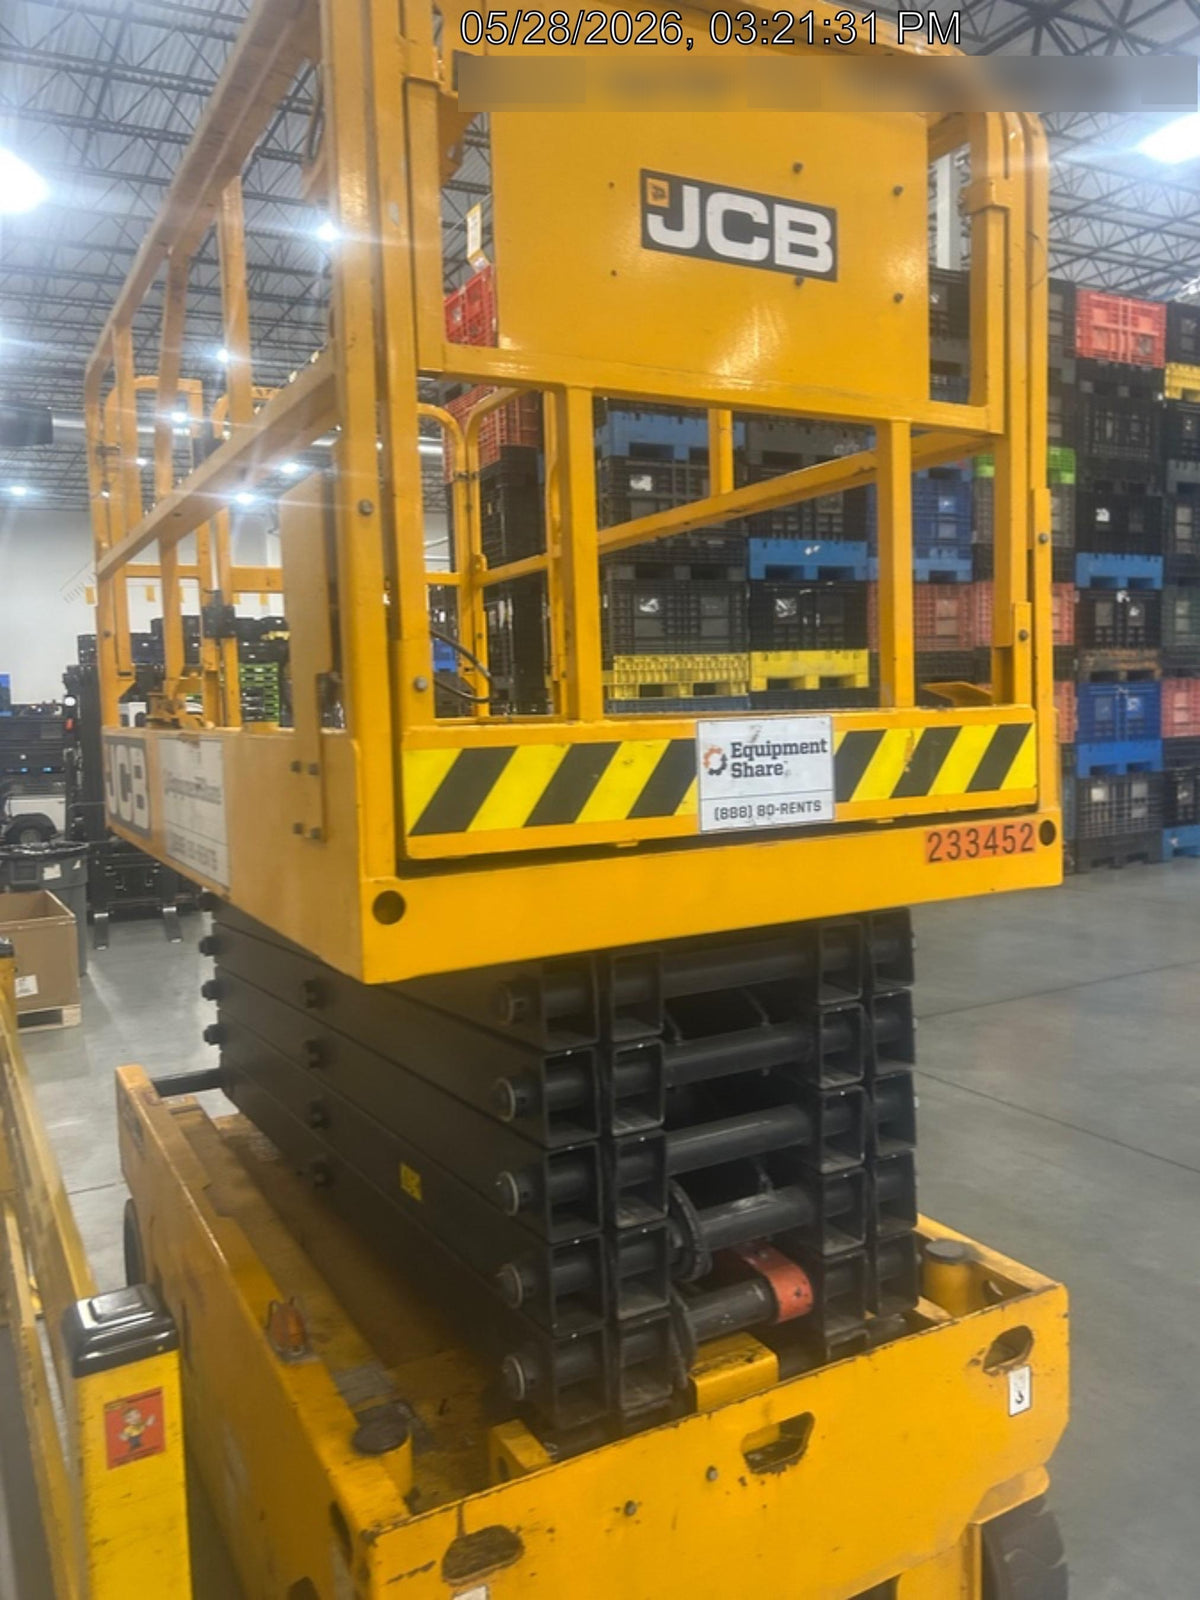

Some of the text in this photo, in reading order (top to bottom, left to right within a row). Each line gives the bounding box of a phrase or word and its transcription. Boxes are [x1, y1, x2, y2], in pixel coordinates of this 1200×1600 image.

[647, 184, 834, 273] JCB
[730, 738, 828, 761] Equipment
[731, 762, 784, 778] Share
[105, 744, 150, 829] JCB
[714, 800, 822, 821] (888) 80-RENTS
[927, 822, 1035, 863] 233452
